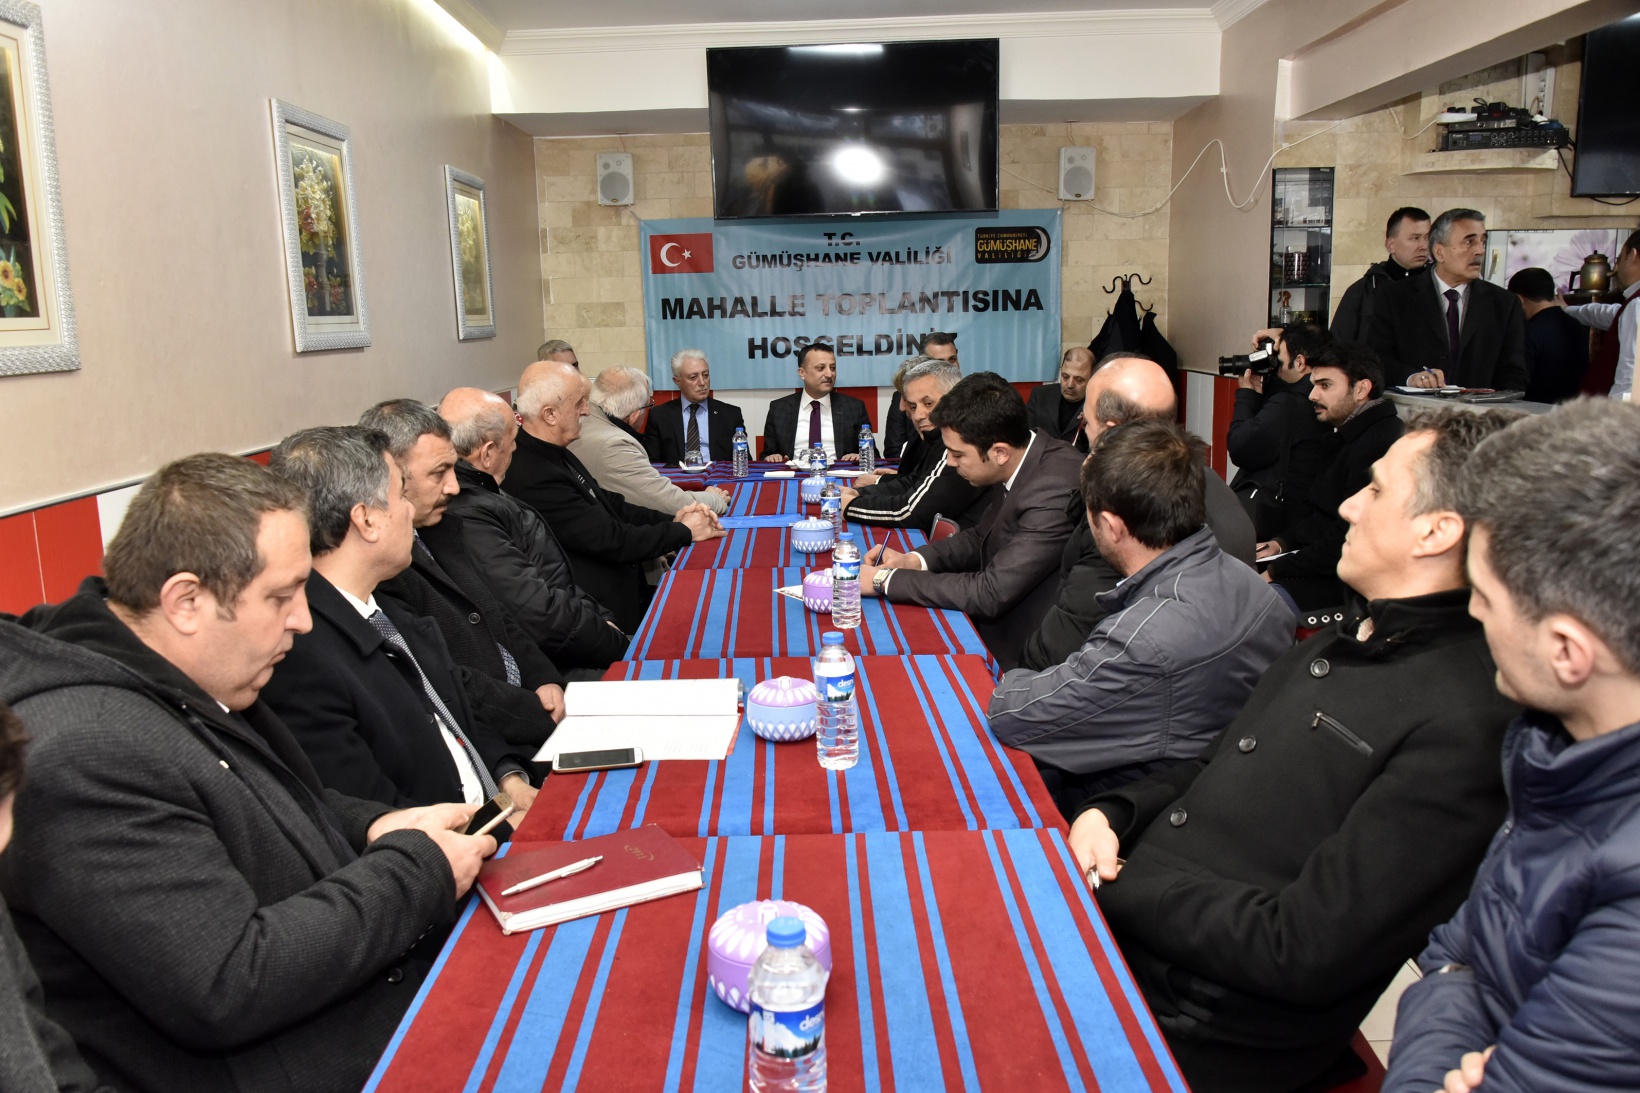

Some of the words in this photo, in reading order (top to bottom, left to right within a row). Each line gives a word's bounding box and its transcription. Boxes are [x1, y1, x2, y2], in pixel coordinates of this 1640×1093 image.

[823, 232, 861, 246] T.C.
[977, 239, 1037, 253] GÜMÜŞHANE
[731, 251, 861, 271] GÜMÜŞHANE
[867, 246, 952, 266] VALİLİĞİ
[661, 295, 806, 320] MAHALLE
[815, 289, 1044, 317] TOPLANTISINA
[747, 328, 958, 359] HOELDİN
